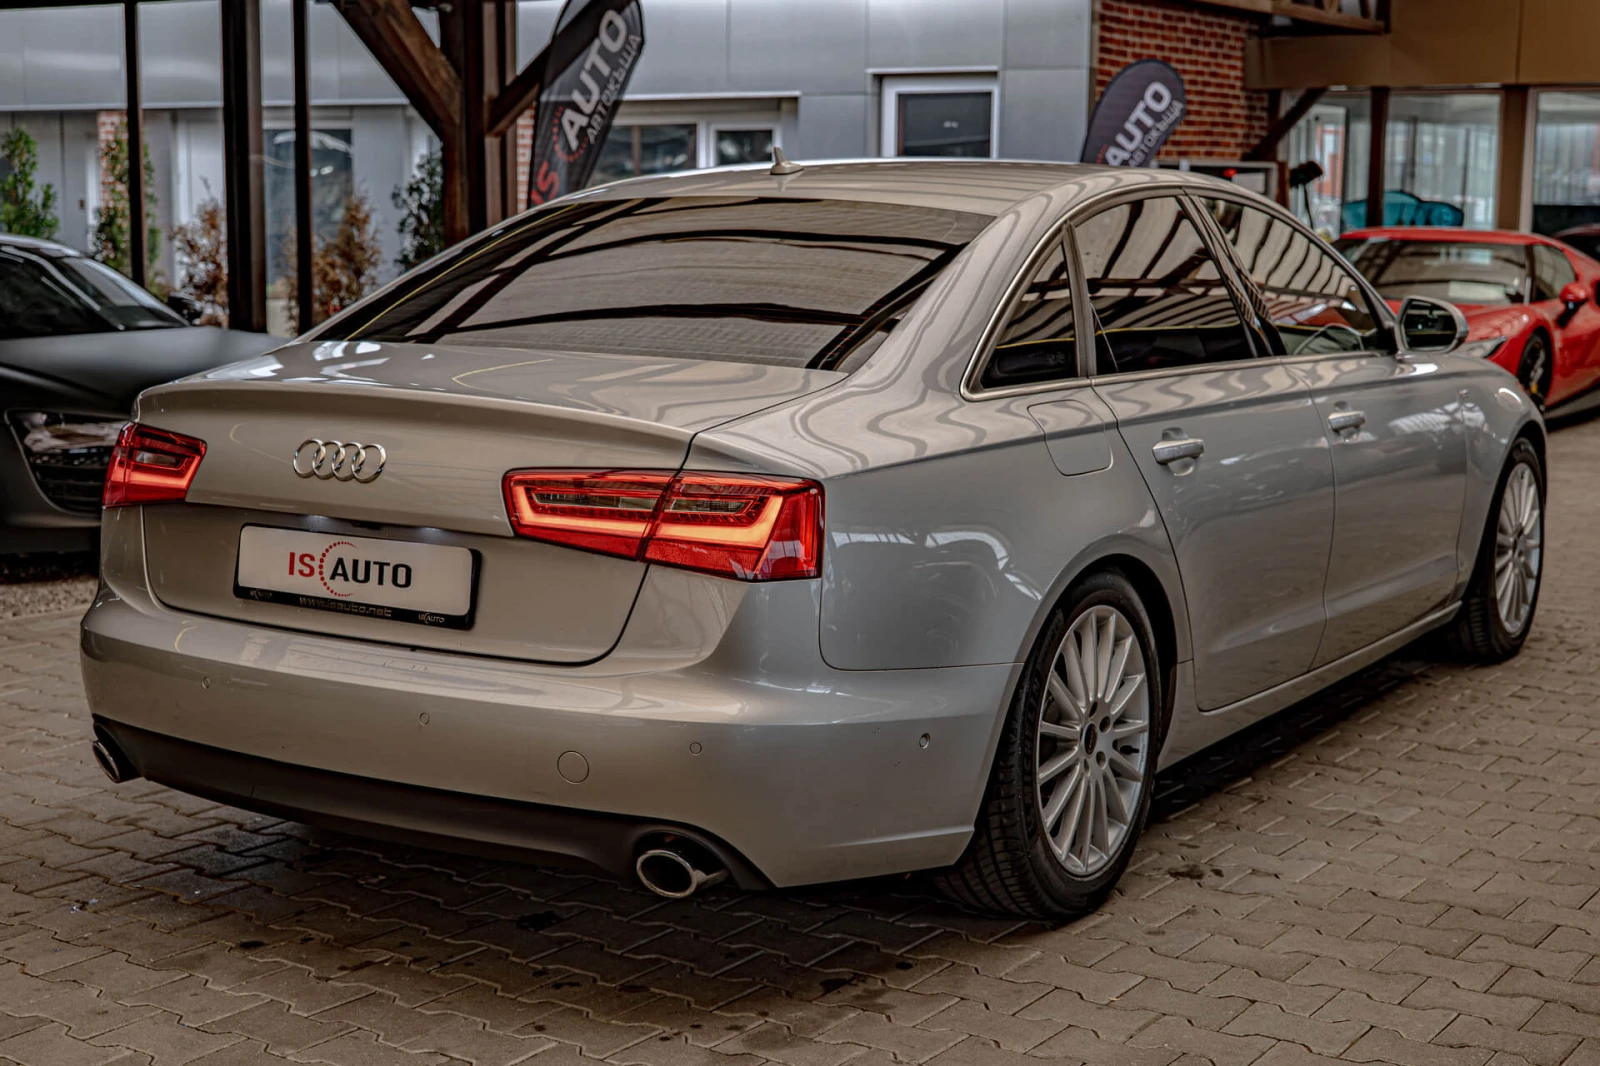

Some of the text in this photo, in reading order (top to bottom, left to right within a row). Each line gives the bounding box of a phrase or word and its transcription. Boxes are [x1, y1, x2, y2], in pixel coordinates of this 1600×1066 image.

[561, 9, 627, 151] AUTO
[1105, 82, 1172, 166] AUTO
[288, 552, 412, 588] IS AUTO
[299, 597, 392, 617] www.isauto.net
